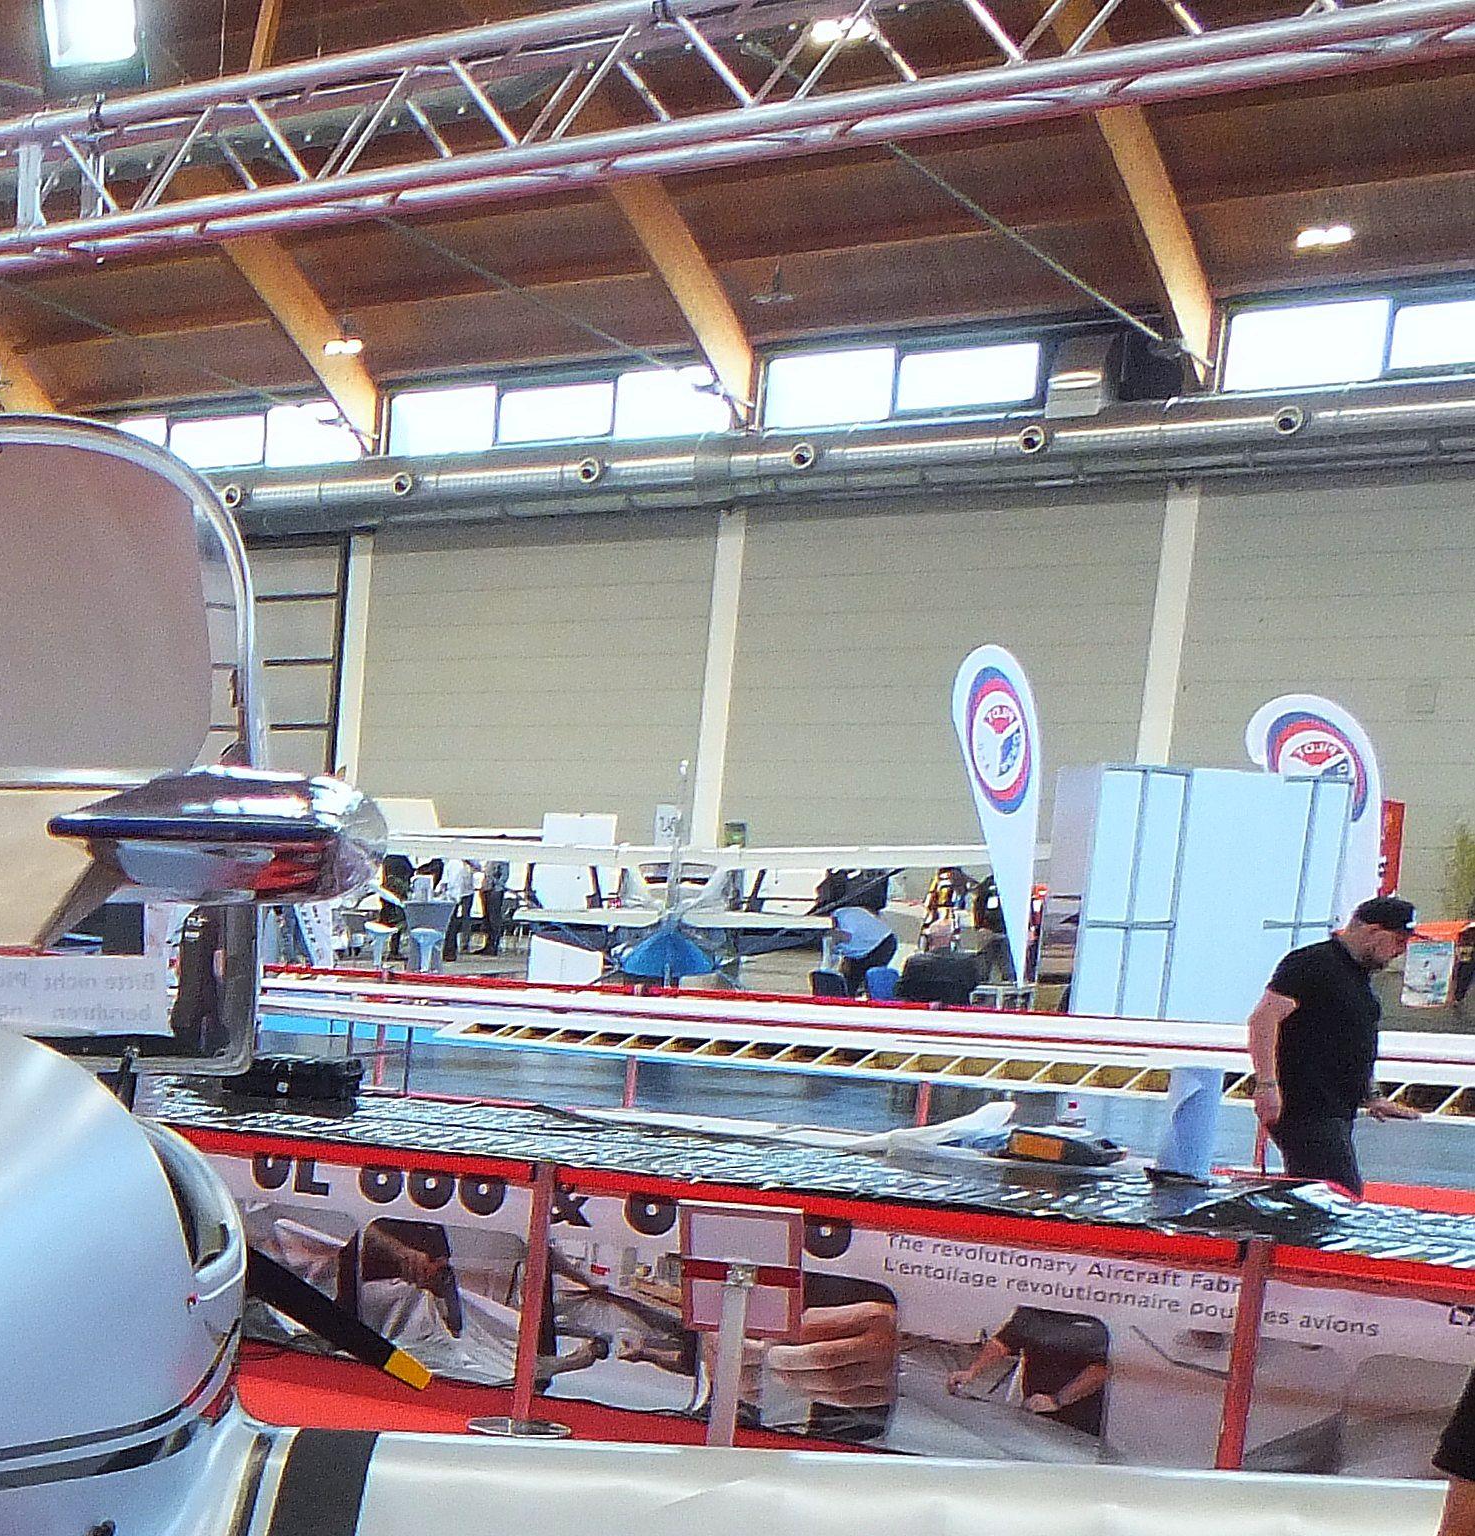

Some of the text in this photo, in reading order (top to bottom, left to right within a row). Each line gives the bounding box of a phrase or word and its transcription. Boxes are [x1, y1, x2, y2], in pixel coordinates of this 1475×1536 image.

[883, 1257, 999, 1288] L'entoilage
[1189, 1302, 1235, 1321] pou
[1263, 1310, 1290, 1325] es
[1299, 1309, 1380, 1337] avions
[887, 1232, 1242, 1294] The revolutionary Aircraft Fabr
